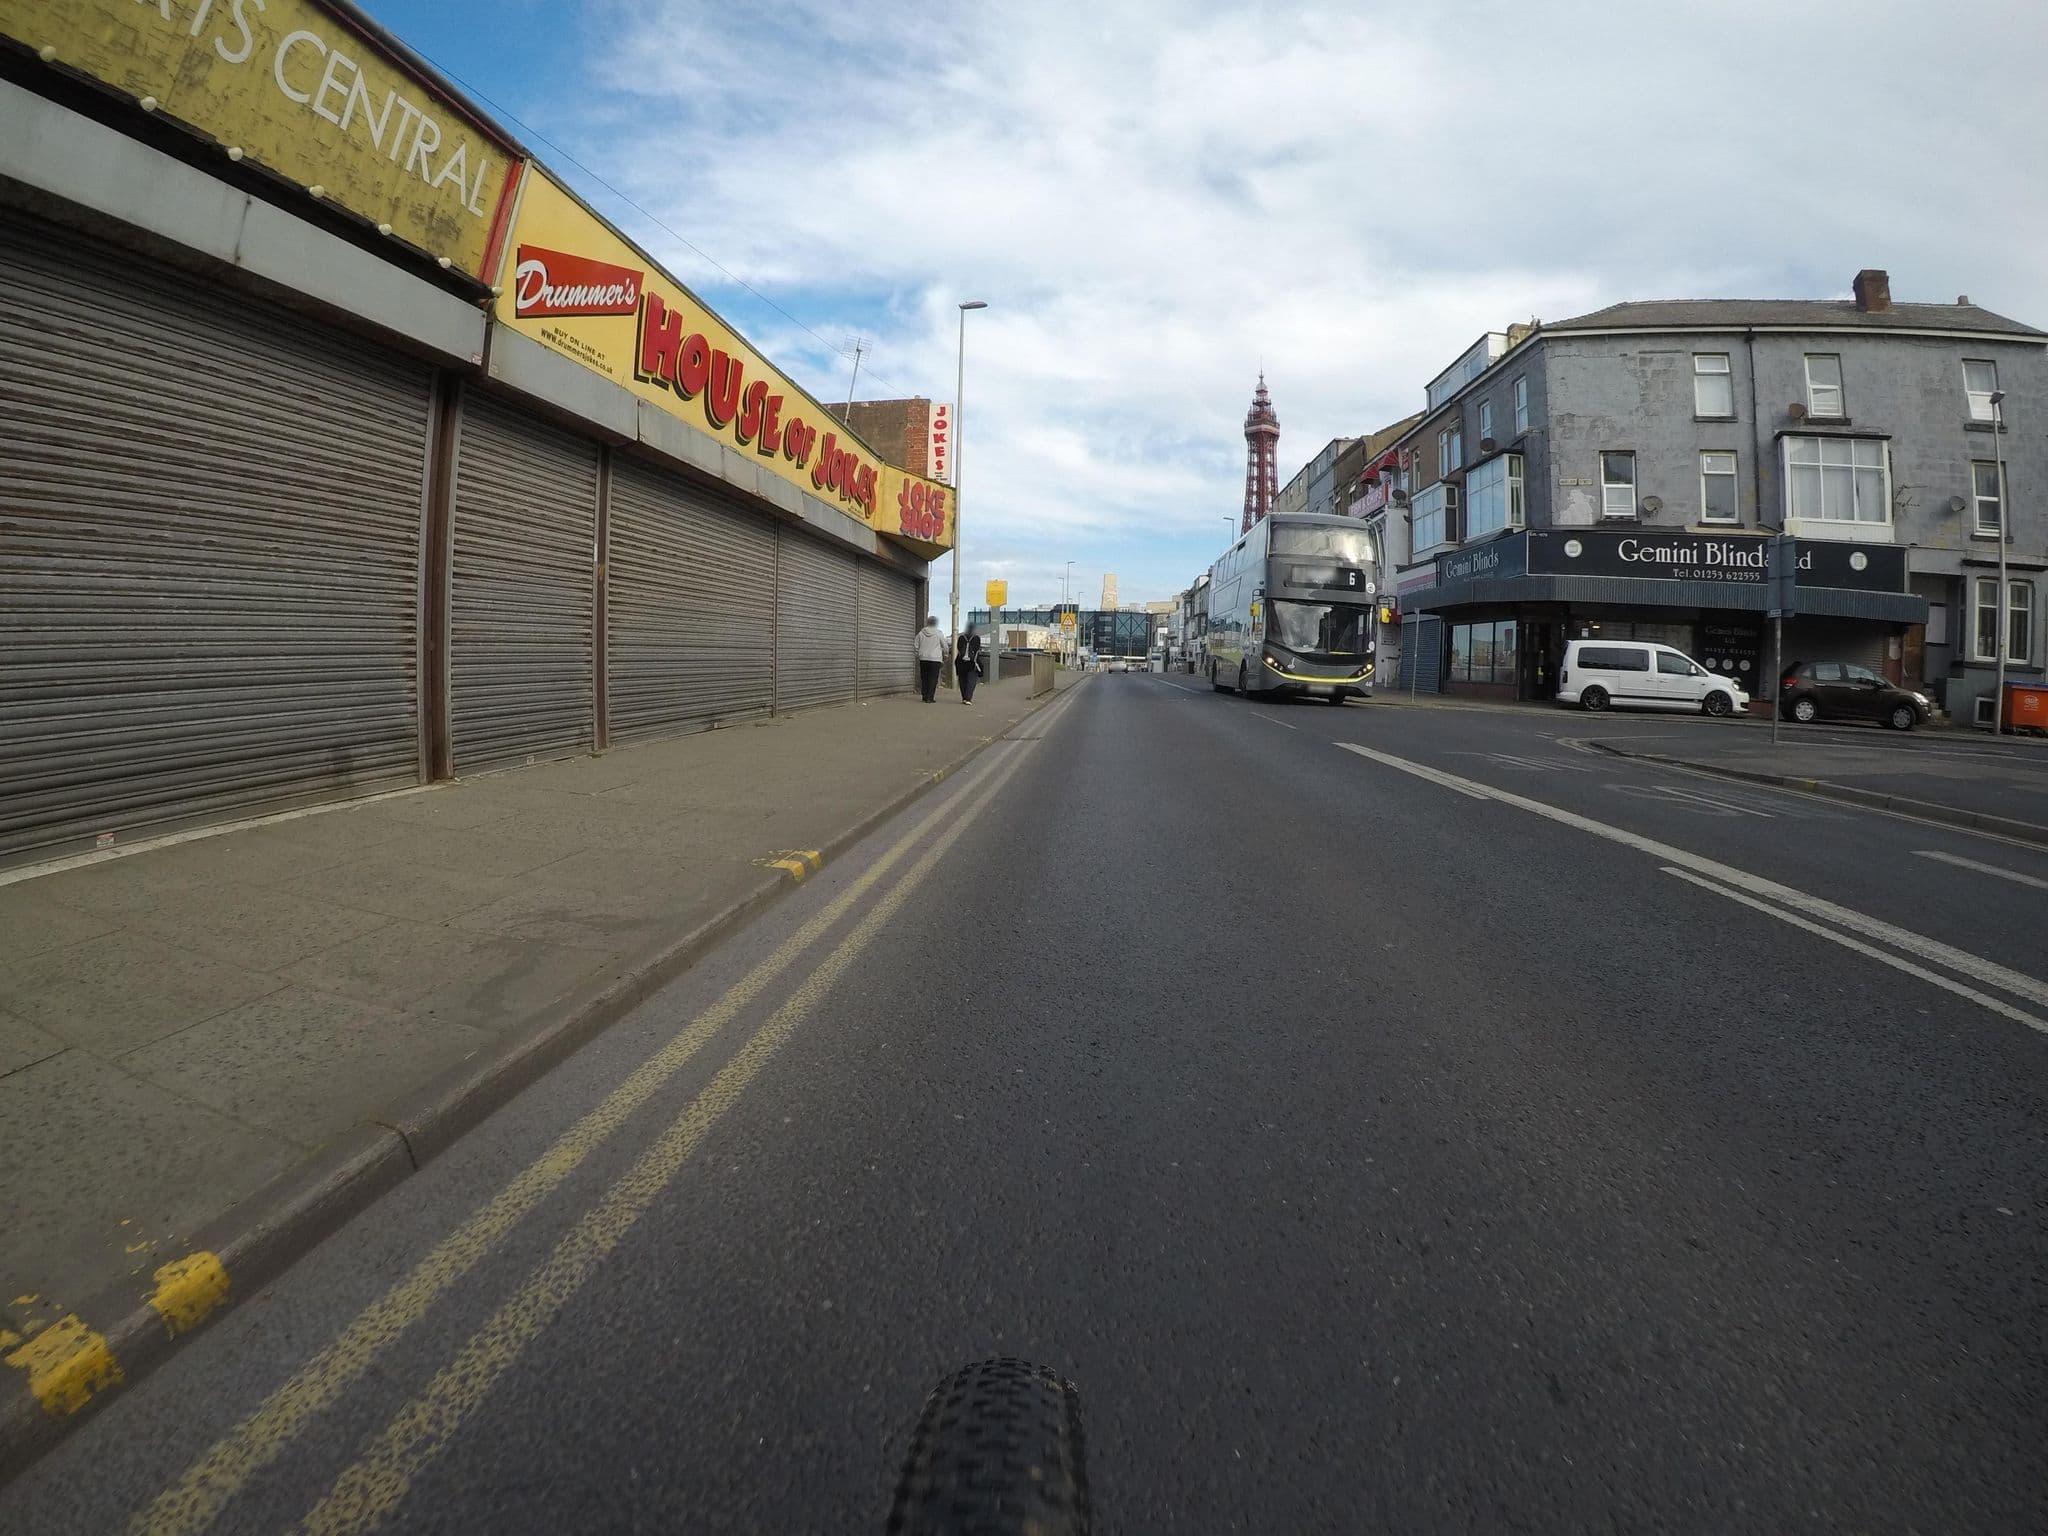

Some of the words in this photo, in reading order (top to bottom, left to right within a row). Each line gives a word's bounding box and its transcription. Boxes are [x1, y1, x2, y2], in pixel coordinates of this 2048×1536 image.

[274, 30, 487, 218] CENTRAL
[516, 259, 636, 310] Drummer's
[554, 327, 568, 339] BUY
[581, 342, 596, 356] LINE
[637, 291, 784, 455] HOUSE
[784, 417, 817, 468] OF
[812, 431, 878, 518] JOKES
[933, 406, 948, 470] JOKES
[898, 477, 945, 520] JOKE
[900, 505, 944, 544] SHOP
[1446, 555, 1472, 578] Gemini
[1472, 547, 1499, 572] Blinds
[1618, 539, 1698, 564] Gemini
[1349, 571, 1356, 586] 6
[1726, 571, 1760, 582] 622555
